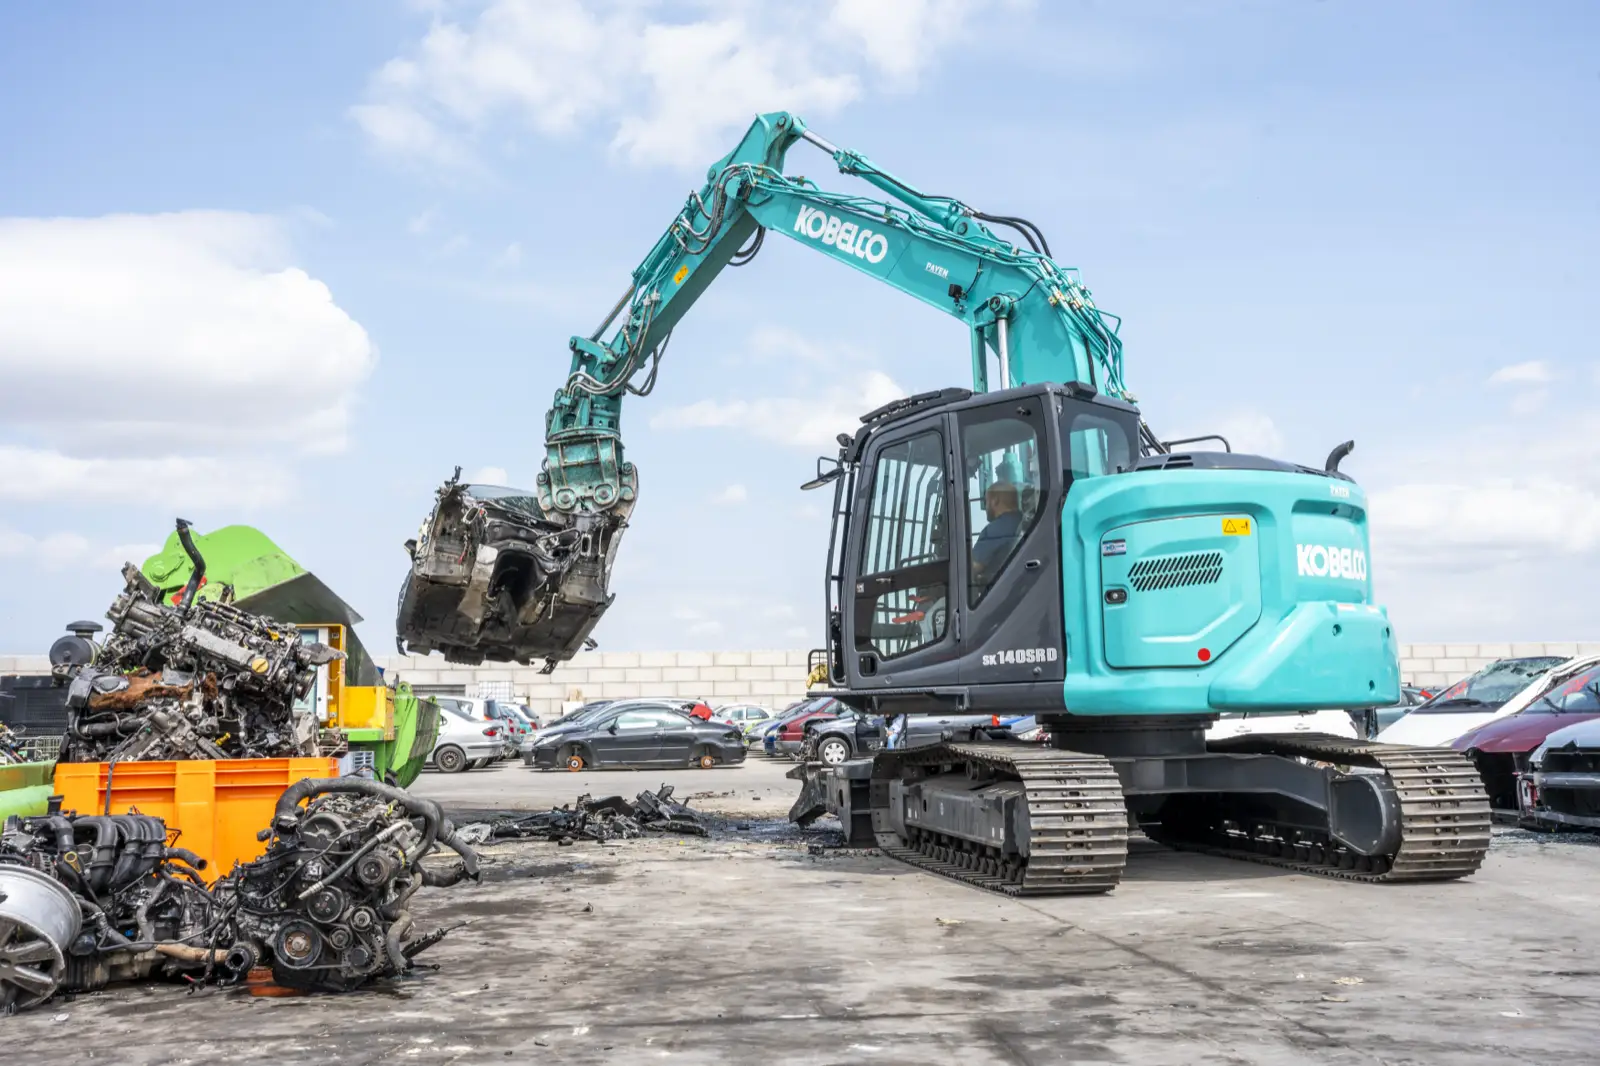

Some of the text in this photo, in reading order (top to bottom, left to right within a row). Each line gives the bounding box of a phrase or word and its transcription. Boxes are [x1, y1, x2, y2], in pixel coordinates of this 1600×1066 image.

[794, 204, 888, 264] KOBELCO
[925, 261, 949, 278] PAYEN
[1296, 544, 1367, 581] KOBELCO
